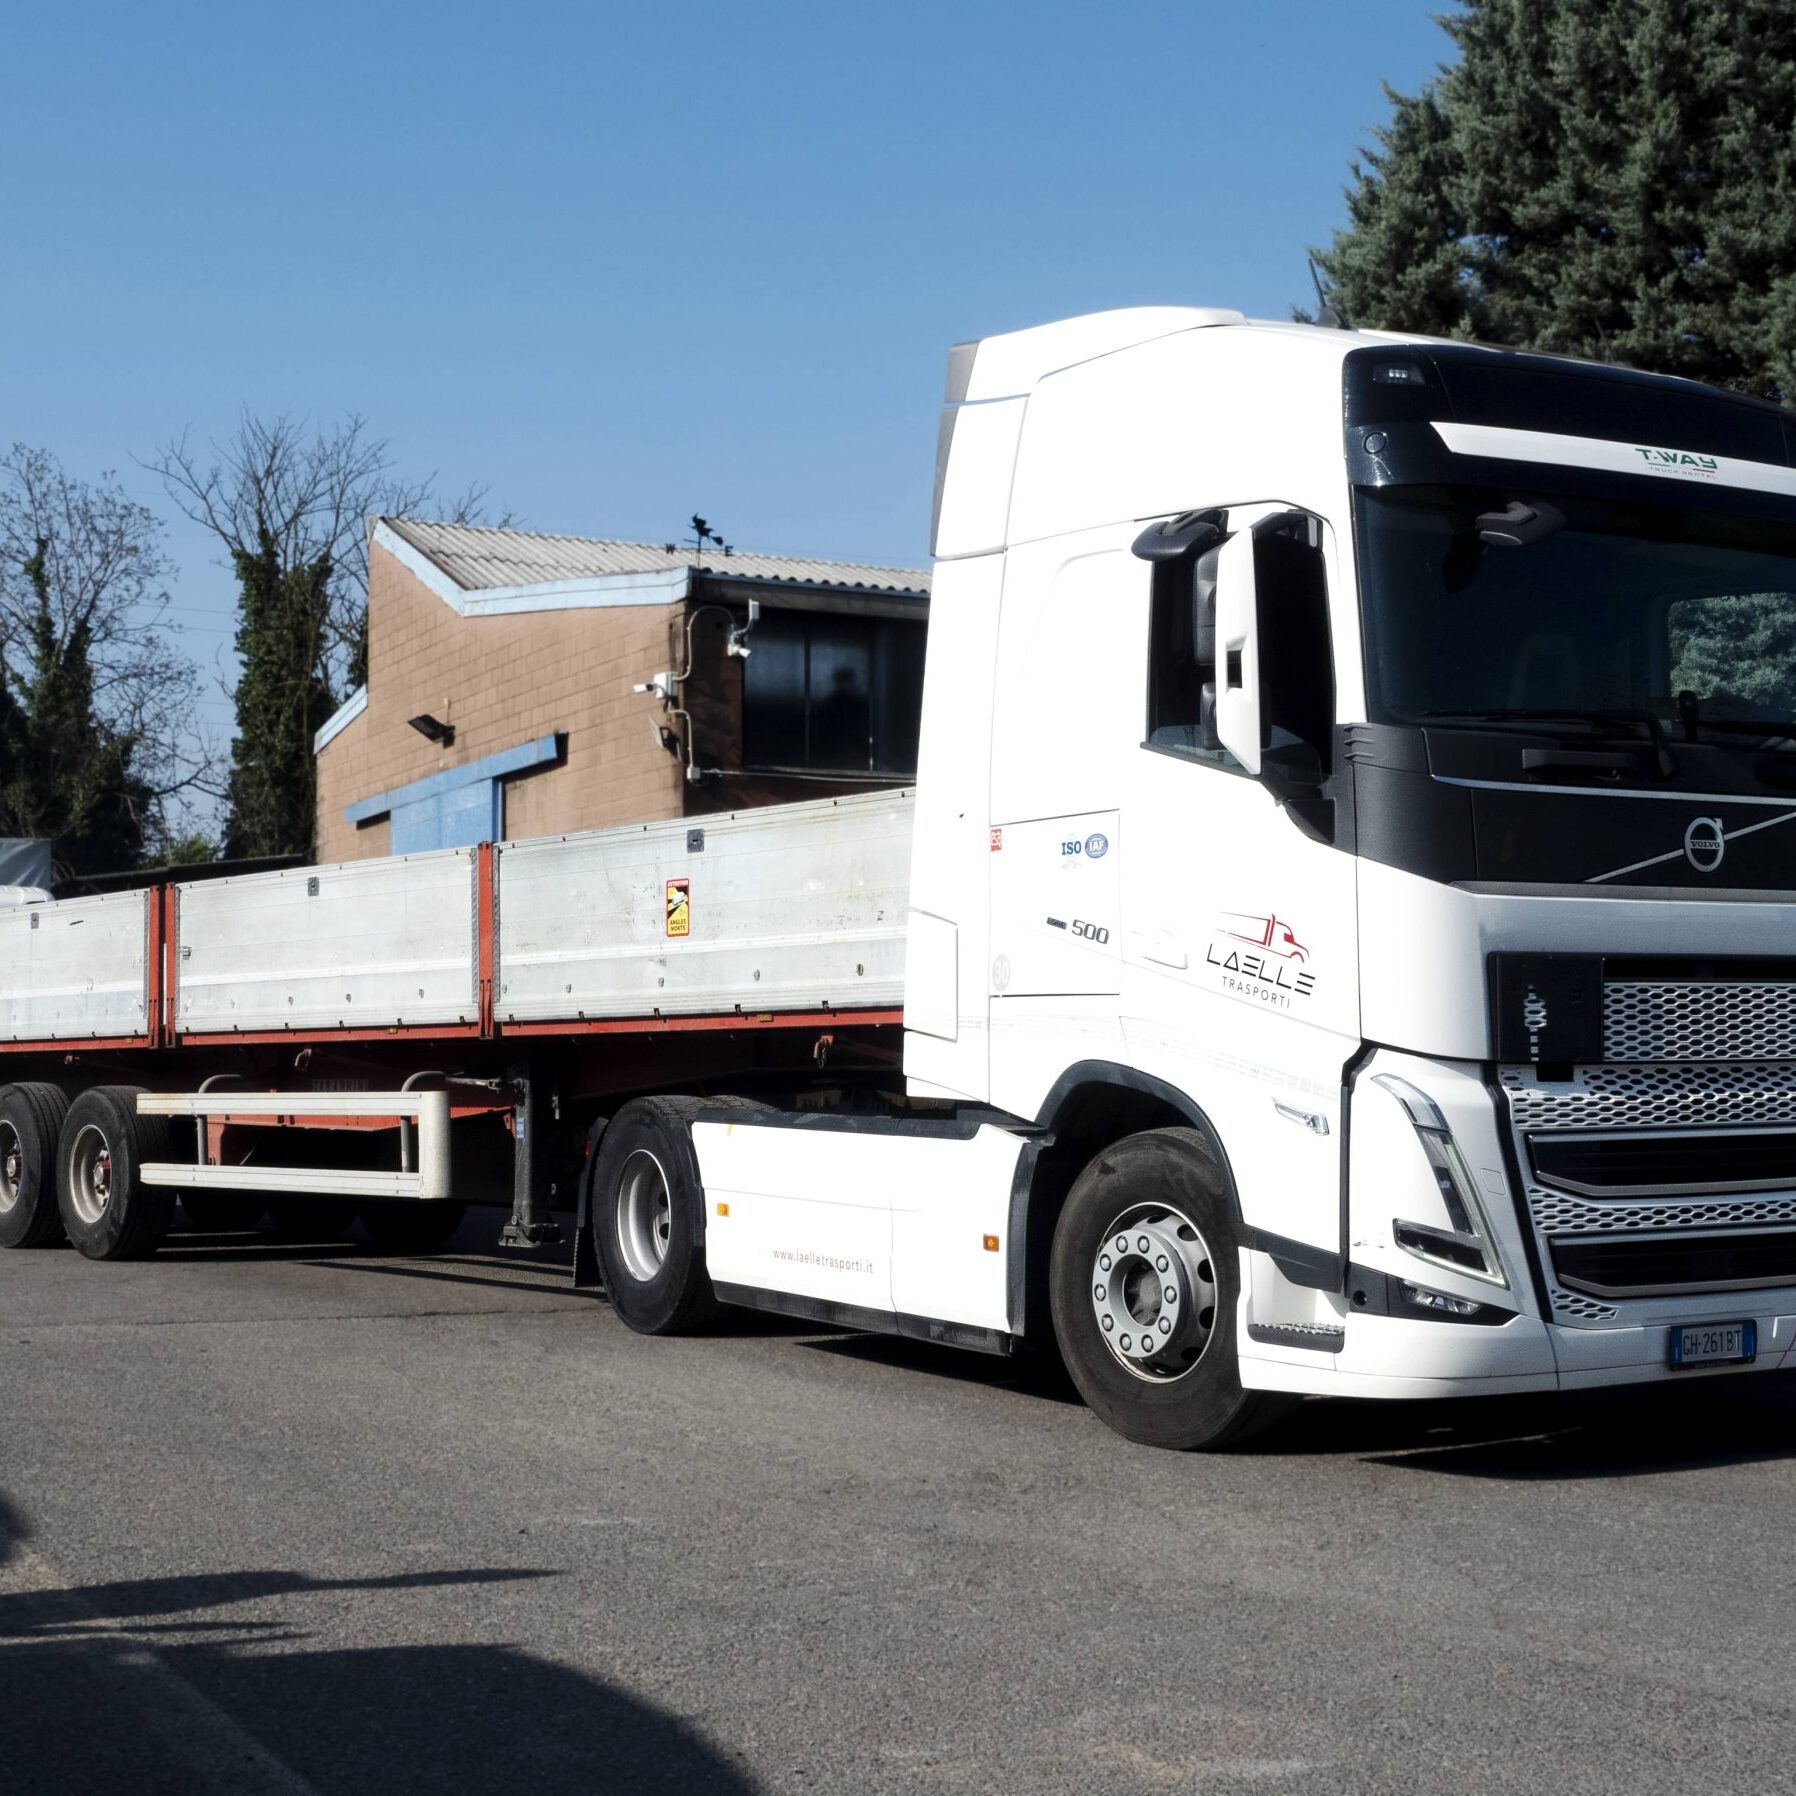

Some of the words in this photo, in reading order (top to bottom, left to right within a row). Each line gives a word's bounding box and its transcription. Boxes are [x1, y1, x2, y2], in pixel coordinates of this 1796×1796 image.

[665, 543, 676, 555] W
[724, 545, 735, 557] E
[1061, 840, 1082, 856] ISO
[1071, 919, 1110, 945] 500
[1222, 975, 1291, 1009] TRASPORTI
[773, 1248, 874, 1274] www.laelletrasporti.it
